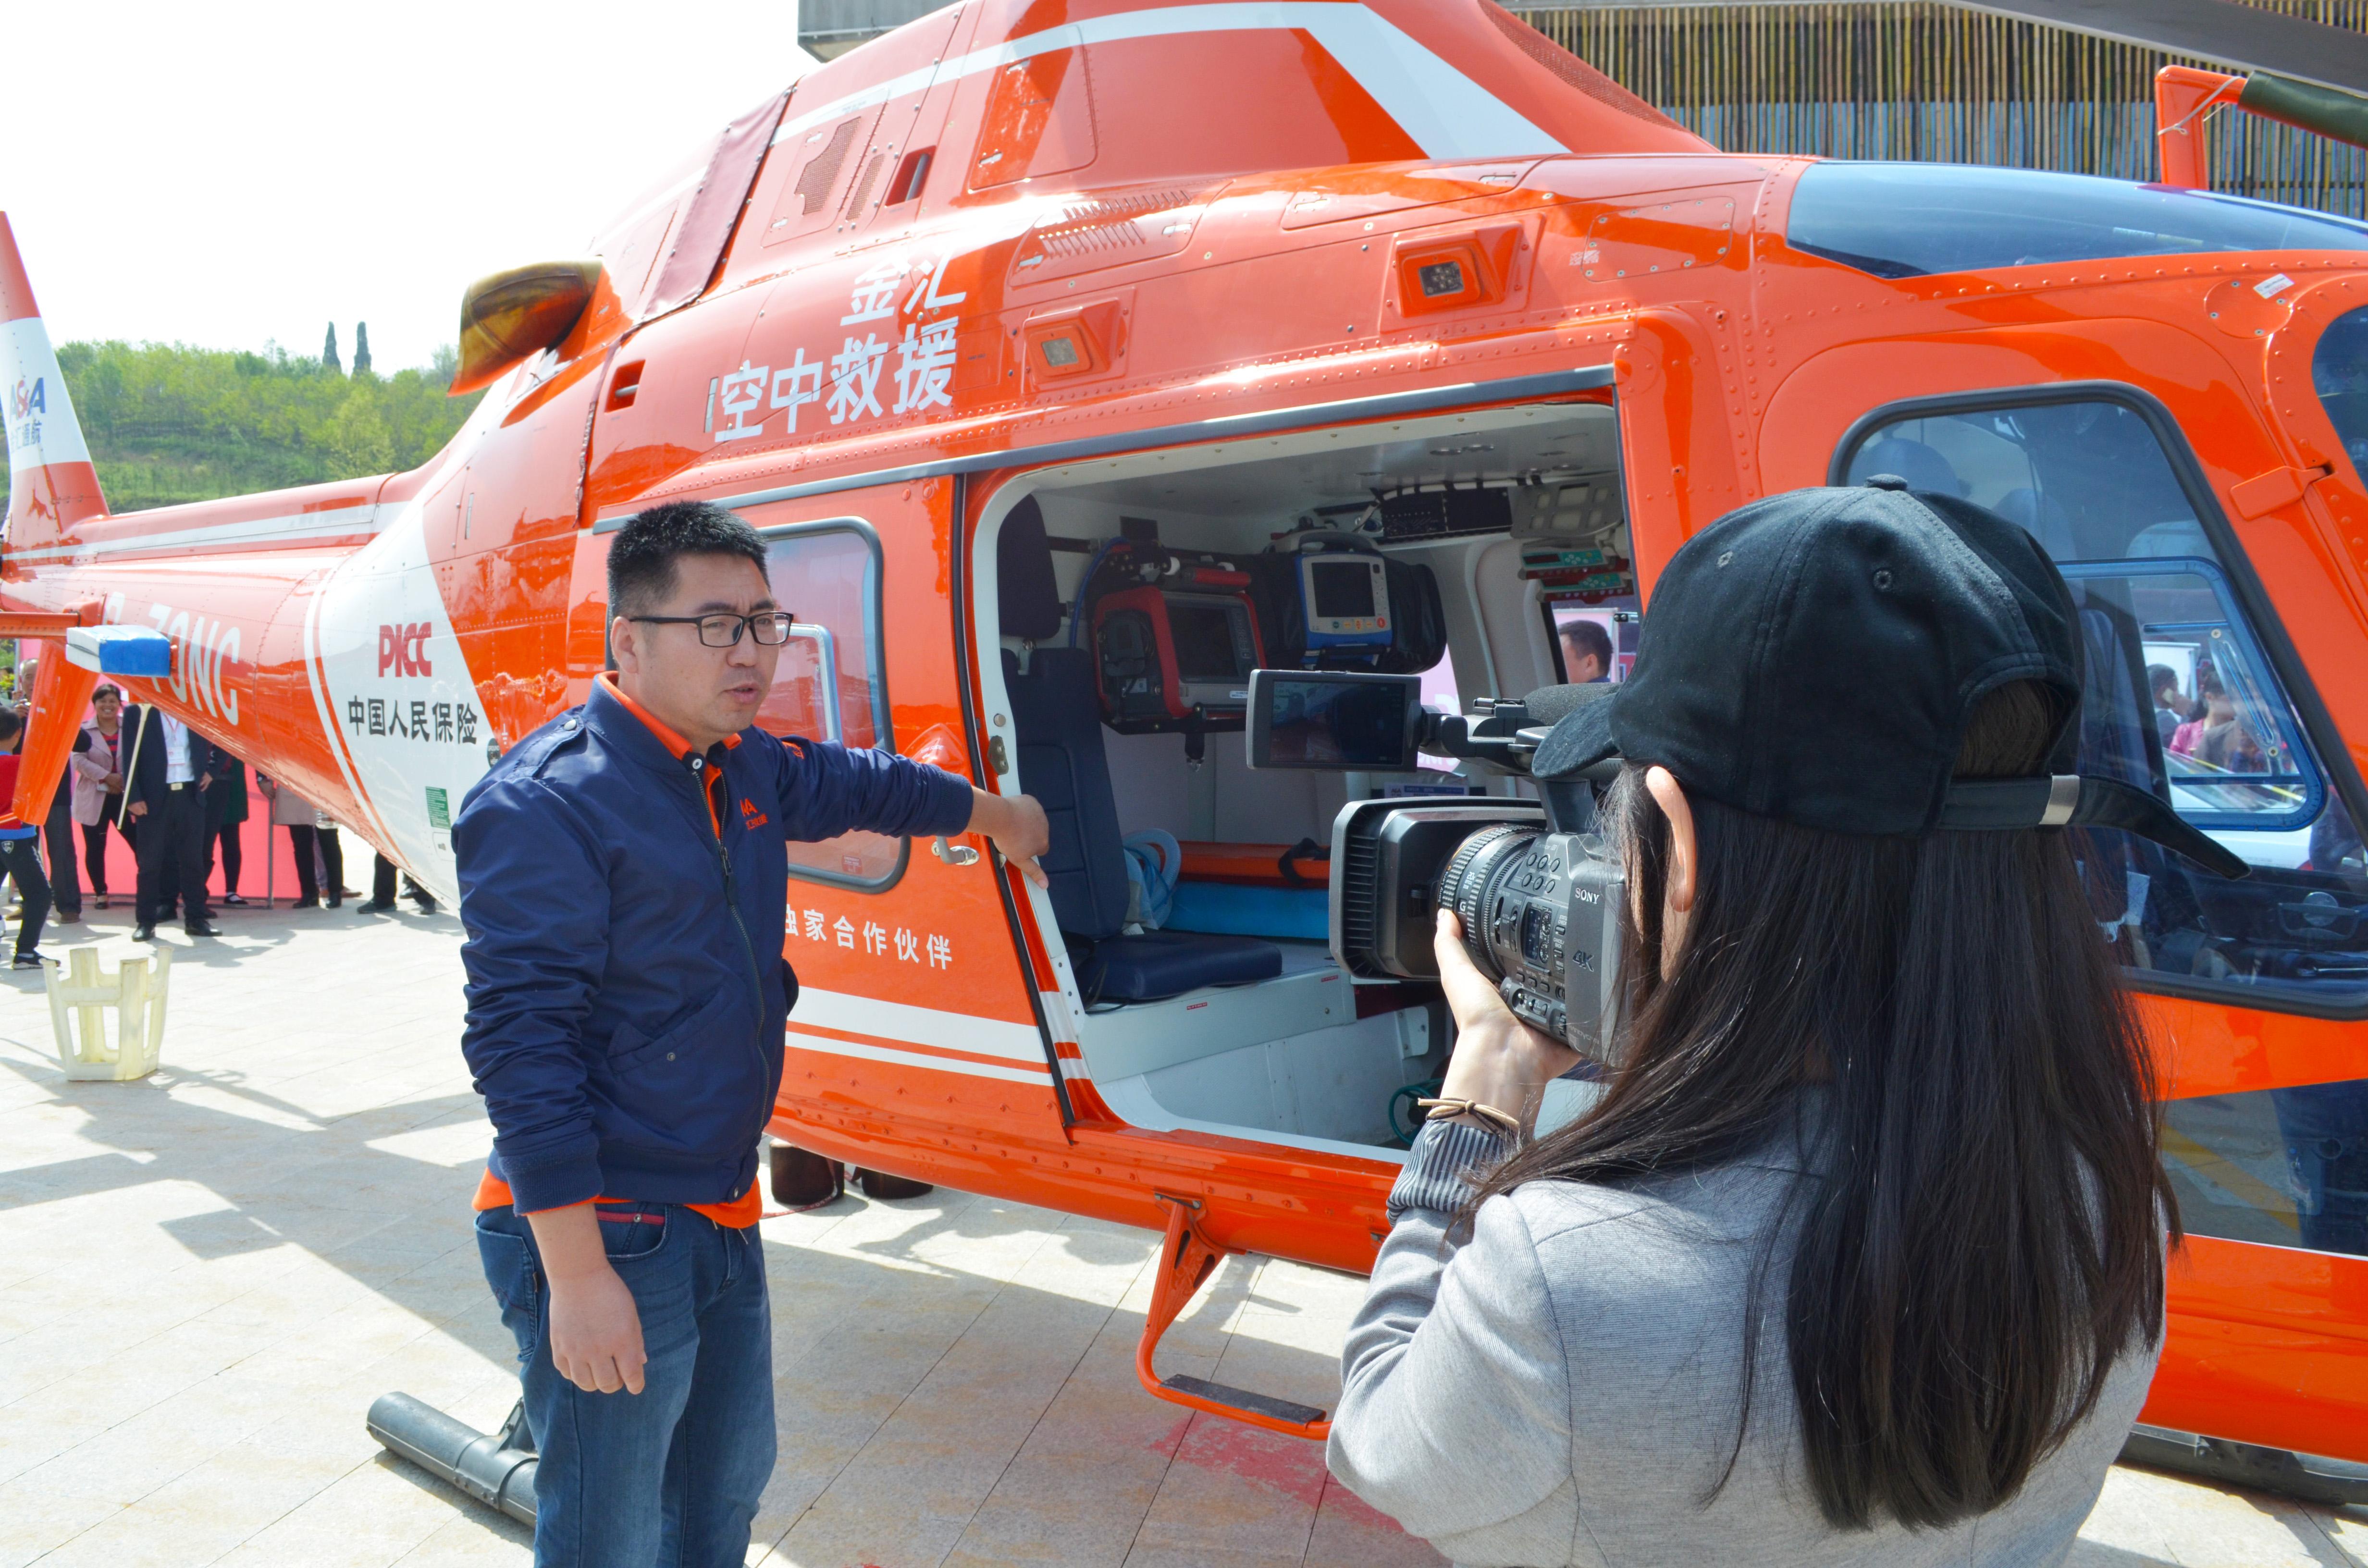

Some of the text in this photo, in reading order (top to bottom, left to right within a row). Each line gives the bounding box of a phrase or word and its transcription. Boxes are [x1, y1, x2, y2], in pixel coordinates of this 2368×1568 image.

[840, 247, 967, 326] 金汇
[714, 316, 959, 442] 空中救援
[378, 622, 432, 677] PICC
[347, 695, 478, 745] 中国人民保险
[1459, 901, 1467, 912] G
[1575, 887, 1600, 904] SONY
[1572, 949, 1595, 972] 4K
